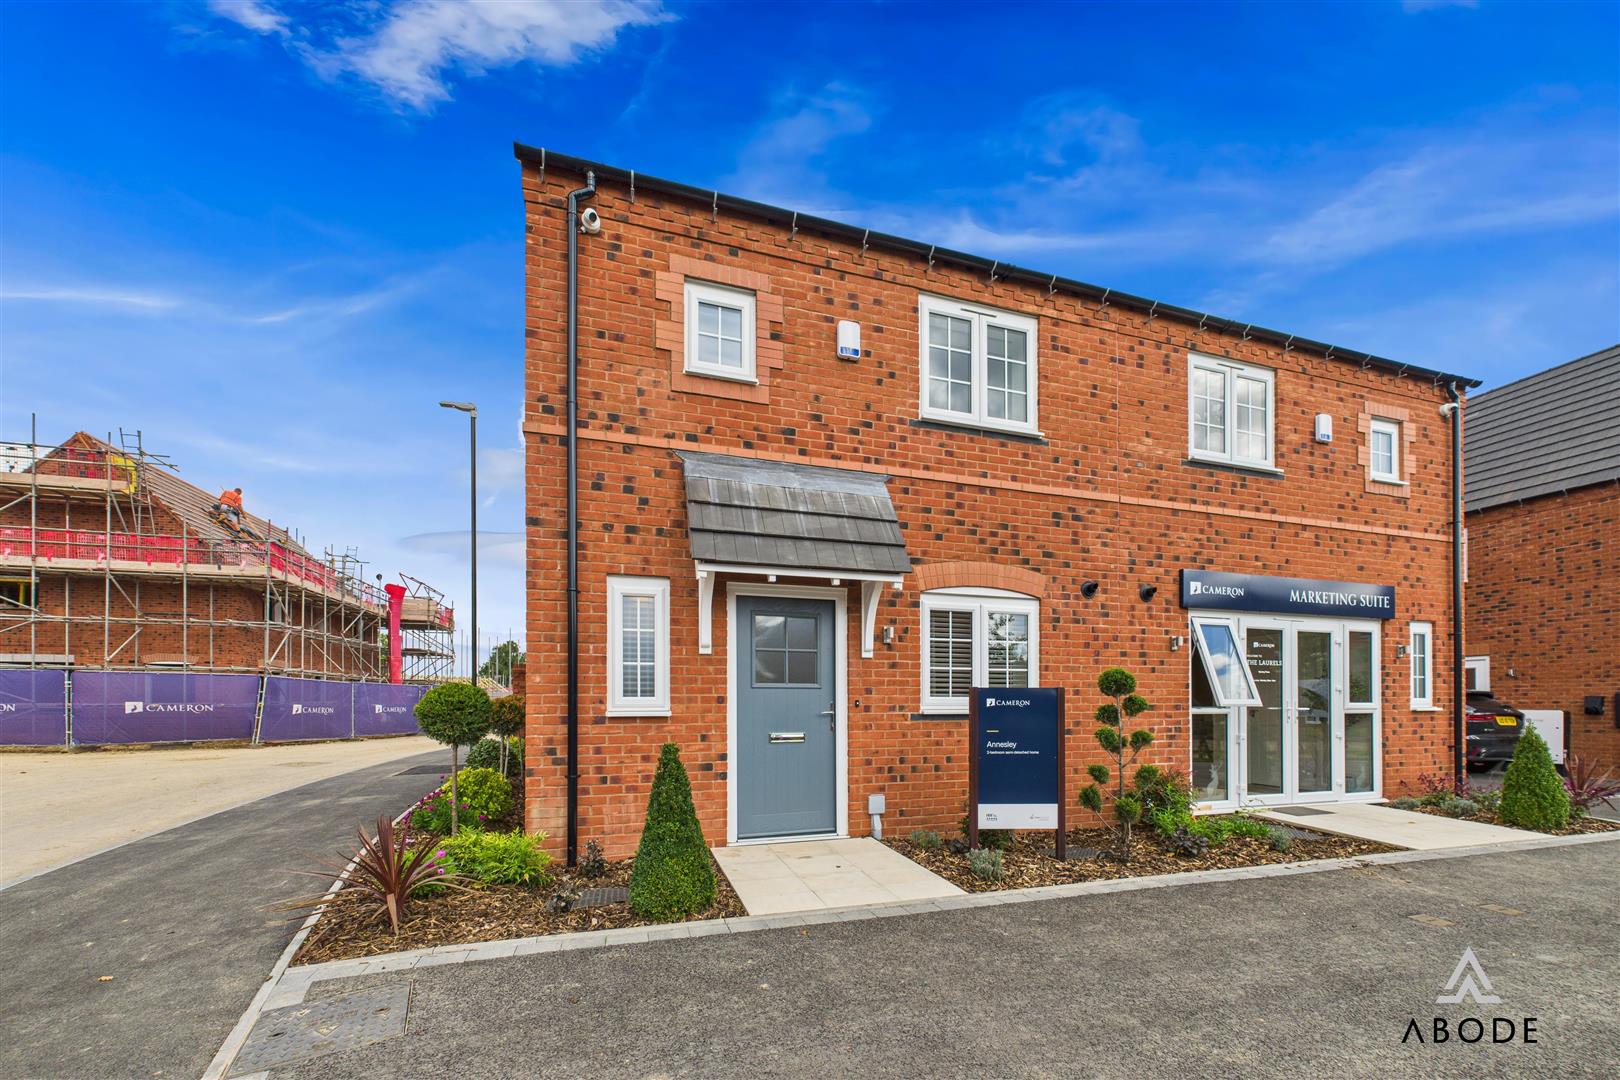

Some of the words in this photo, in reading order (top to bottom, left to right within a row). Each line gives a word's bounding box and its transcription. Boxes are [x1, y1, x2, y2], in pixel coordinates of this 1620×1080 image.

[1202, 585, 1245, 599] CAMERON
[1289, 589, 1357, 606] MARKETING
[1360, 594, 1390, 609] SUITE
[145, 703, 214, 714] CAMERON
[996, 699, 1031, 708] CAMERON
[302, 706, 335, 716] CAMERON
[382, 706, 407, 714] CAMERON
[986, 740, 1018, 750] Annesley
